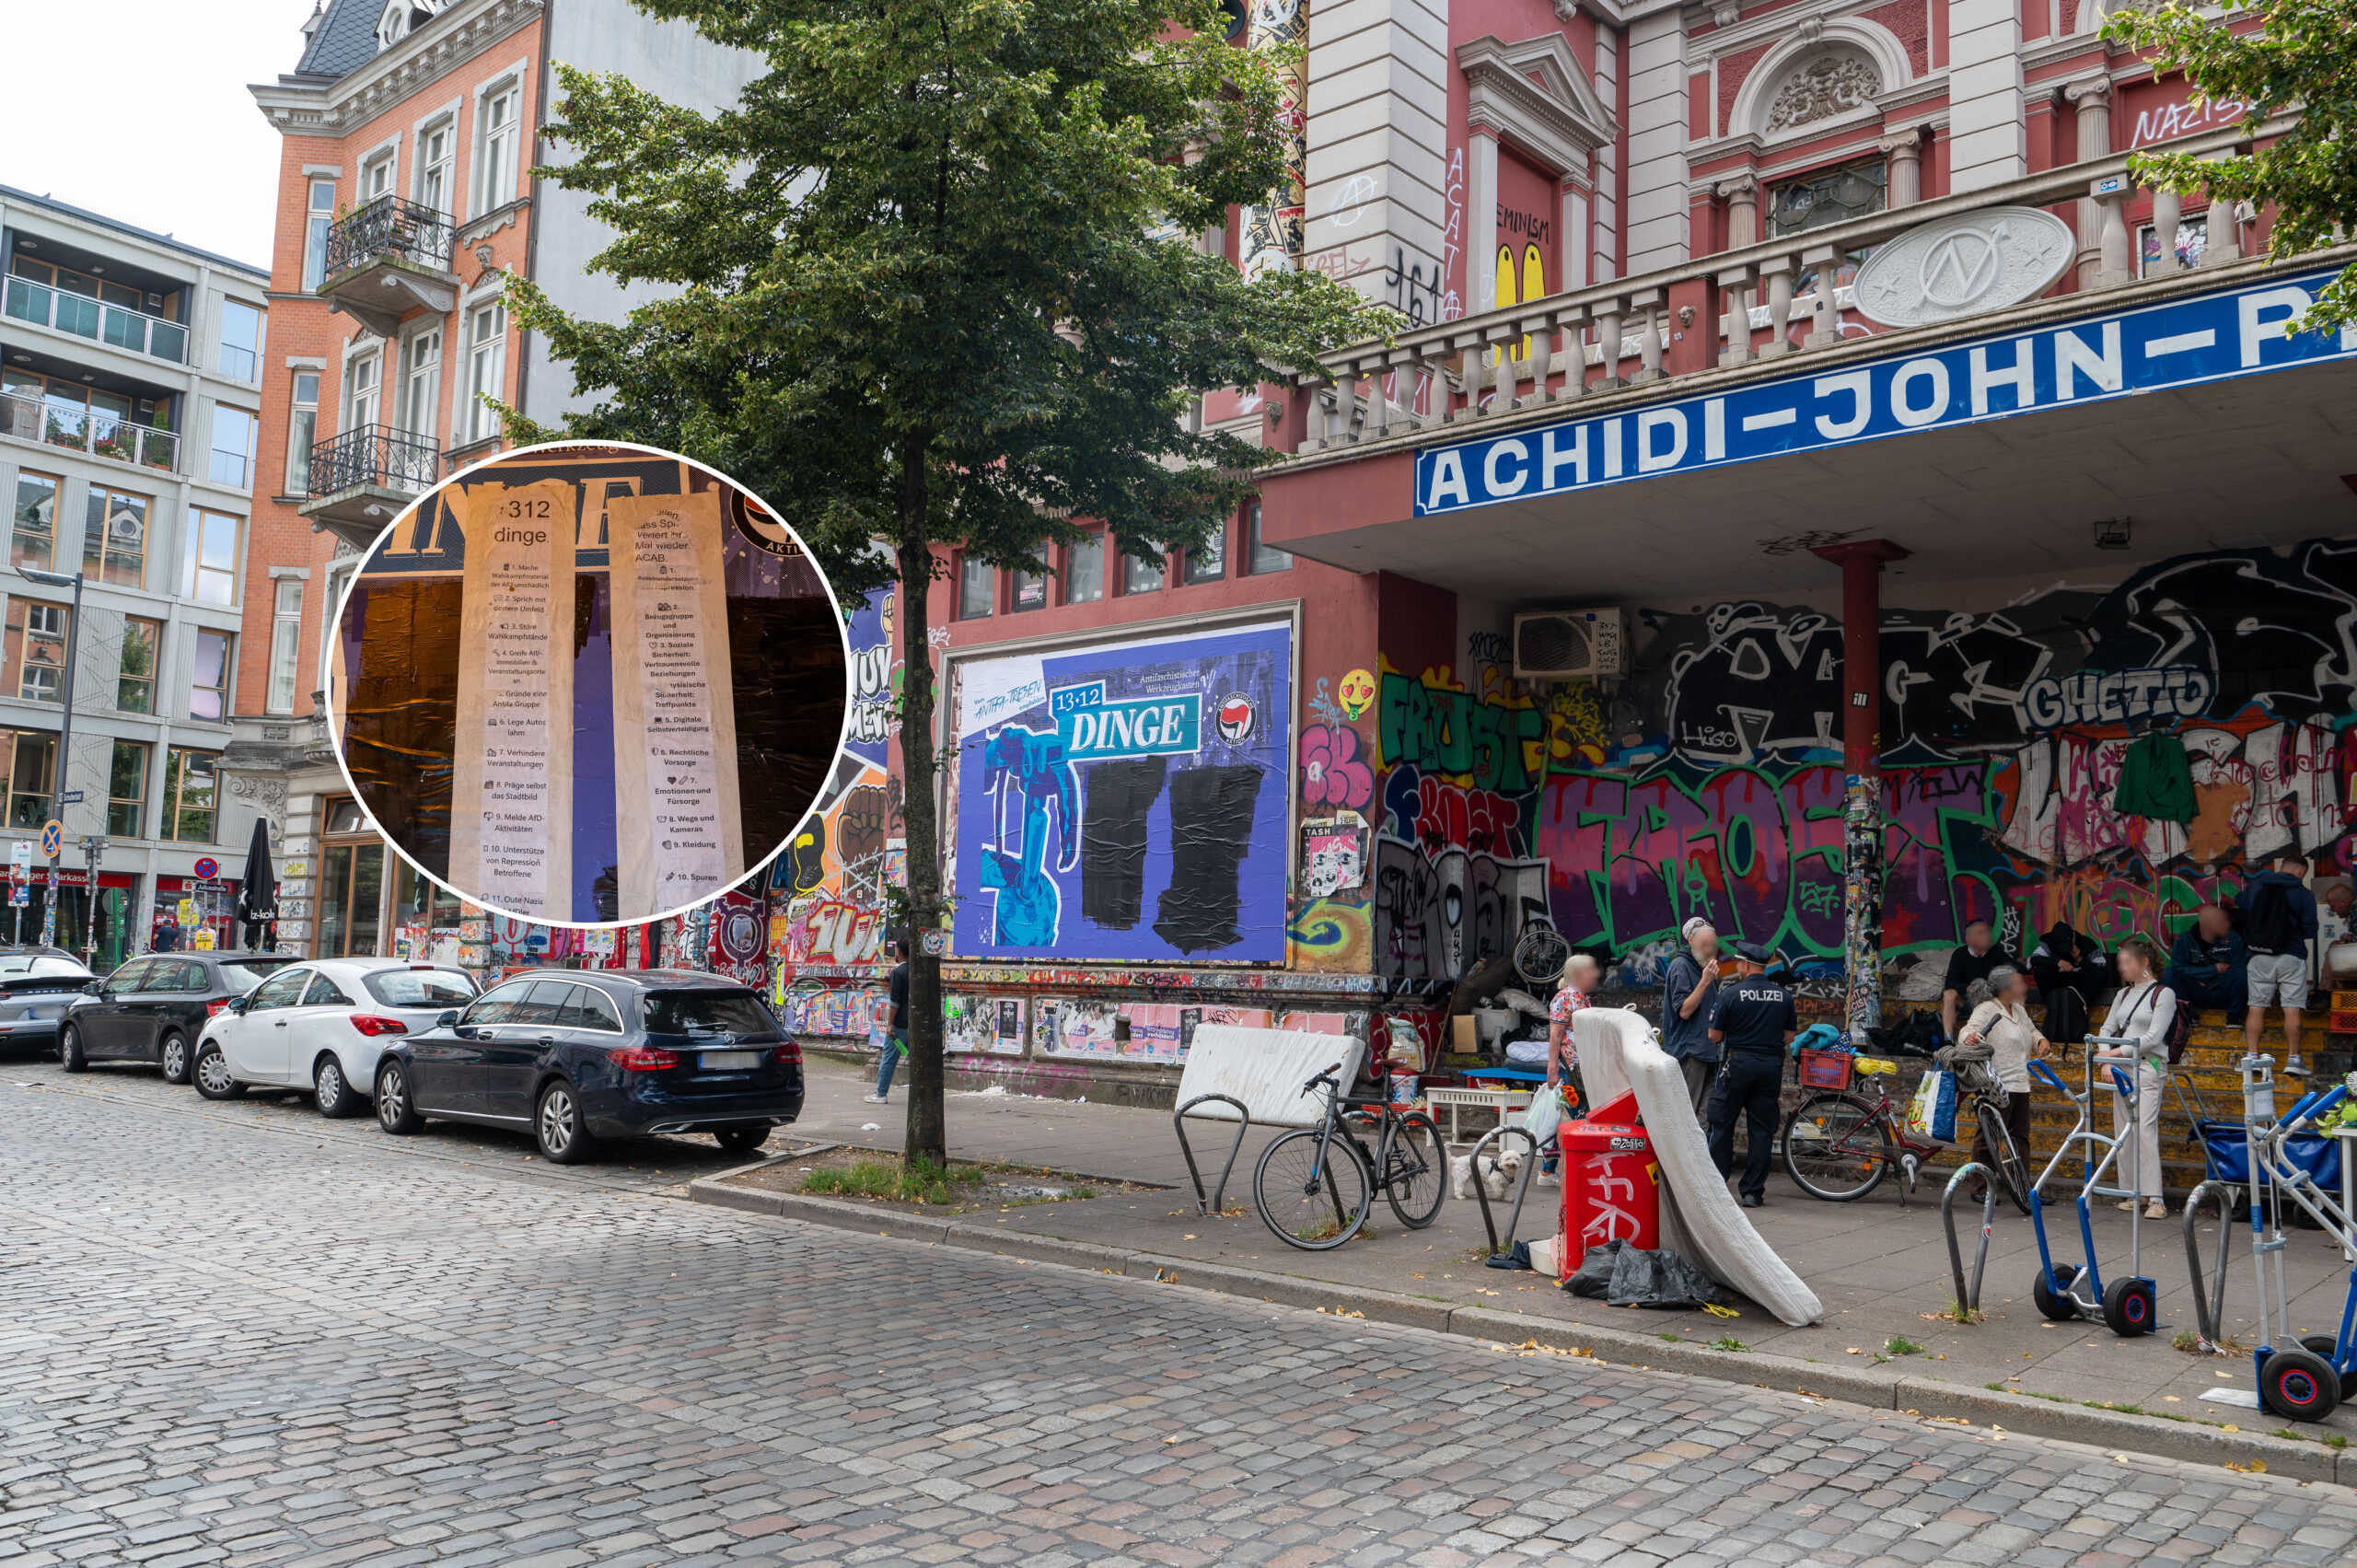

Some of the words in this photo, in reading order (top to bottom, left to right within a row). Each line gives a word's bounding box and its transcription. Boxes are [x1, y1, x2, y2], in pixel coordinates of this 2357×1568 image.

[634, 541, 653, 551] Mal
[656, 541, 691, 551] wieder.
[635, 553, 668, 563] ACAB.
[492, 573, 549, 582] Wahlkampfmaterial
[512, 595, 533, 604] Sprich
[519, 605, 545, 613] Umfeld
[488, 633, 549, 641] Wahlkampfstände
[488, 668, 546, 677] Veranstaltungsorte
[1139, 668, 1201, 684] Antifaschistischer
[1145, 679, 1201, 694] Werkzeugkasten
[2026, 667, 2213, 728] GHETTO
[514, 701, 540, 709] Gruppe
[647, 726, 710, 734] Selbstverteidigung
[1068, 703, 1187, 753] DINGE
[1225, 736, 1246, 746] AKTION
[506, 749, 546, 757] Verhindere
[486, 760, 544, 769] Veranstaltungen
[663, 759, 697, 768] Vorsorge
[504, 781, 525, 790] Präge
[667, 797, 701, 807] Fürsorge
[677, 815, 699, 823] Wege
[682, 841, 716, 849] Kleidung
[503, 845, 545, 855] Unterstütze
[501, 857, 541, 866] Repression
[493, 868, 532, 877] Betroffene
[504, 895, 522, 903] Oute
[523, 897, 543, 905] Nazis
